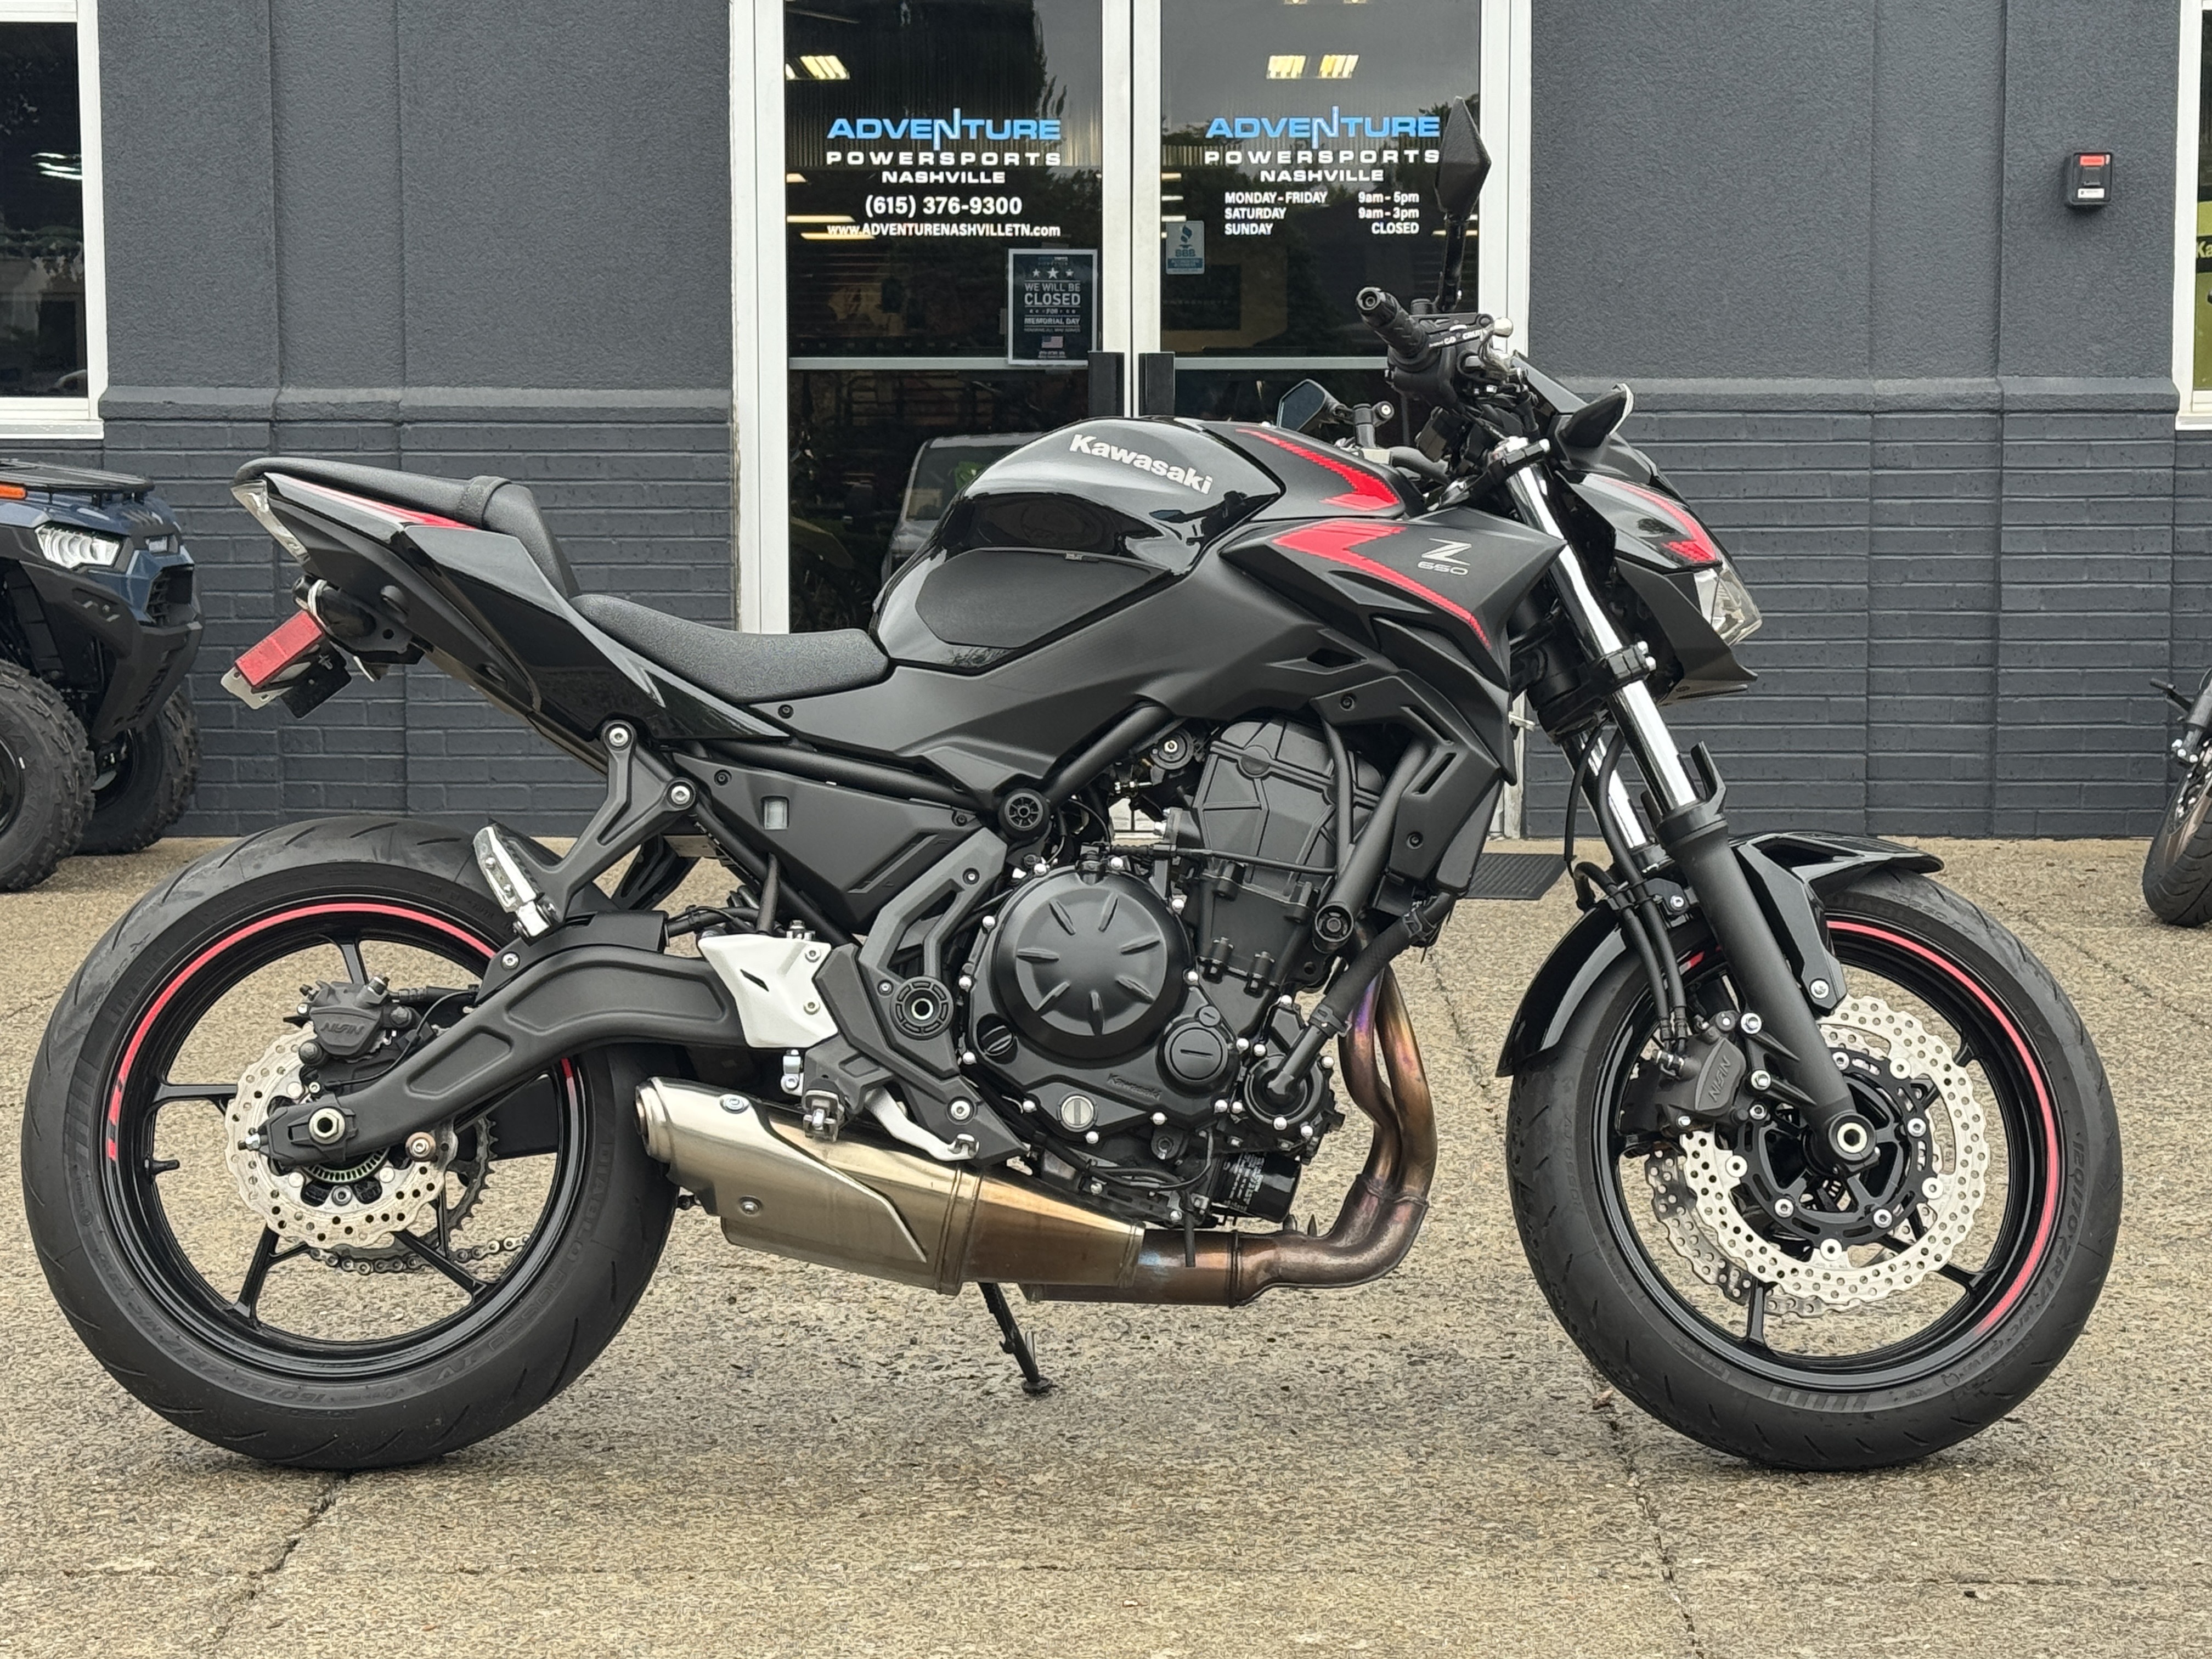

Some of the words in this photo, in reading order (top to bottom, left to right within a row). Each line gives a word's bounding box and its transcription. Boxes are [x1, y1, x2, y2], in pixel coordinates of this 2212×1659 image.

[827, 108, 1061, 151] ADVENTURE
[1206, 106, 1440, 149] ADVENTURE
[827, 152, 1061, 166] POWERSPORTS
[1205, 150, 1440, 164] POWERSPORTS
[882, 171, 1005, 183] NASHVILLE
[1260, 169, 1384, 182] NASHVILLE
[865, 194, 916, 218] (615)
[923, 196, 1022, 215] 376-9300
[1224, 207, 1286, 219] SATURDAY
[827, 223, 1060, 238] www.ADVENTURENASHVILLETN.com
[1224, 223, 1273, 235] SUNDAY
[1371, 222, 1419, 234] CLOSED
[1175, 249, 1196, 257] BBB
[1024, 283, 1040, 292] WE
[1042, 283, 1065, 292] WILL
[1068, 283, 1081, 292] BE
[1024, 292, 1081, 306] CLOSED
[1070, 434, 1213, 494] Kawasaki
[1421, 538, 1472, 566] Z
[1418, 560, 1469, 575] 650
[565, 1146, 612, 1263] DIABLO
[486, 1268, 568, 1353] ROSSO
